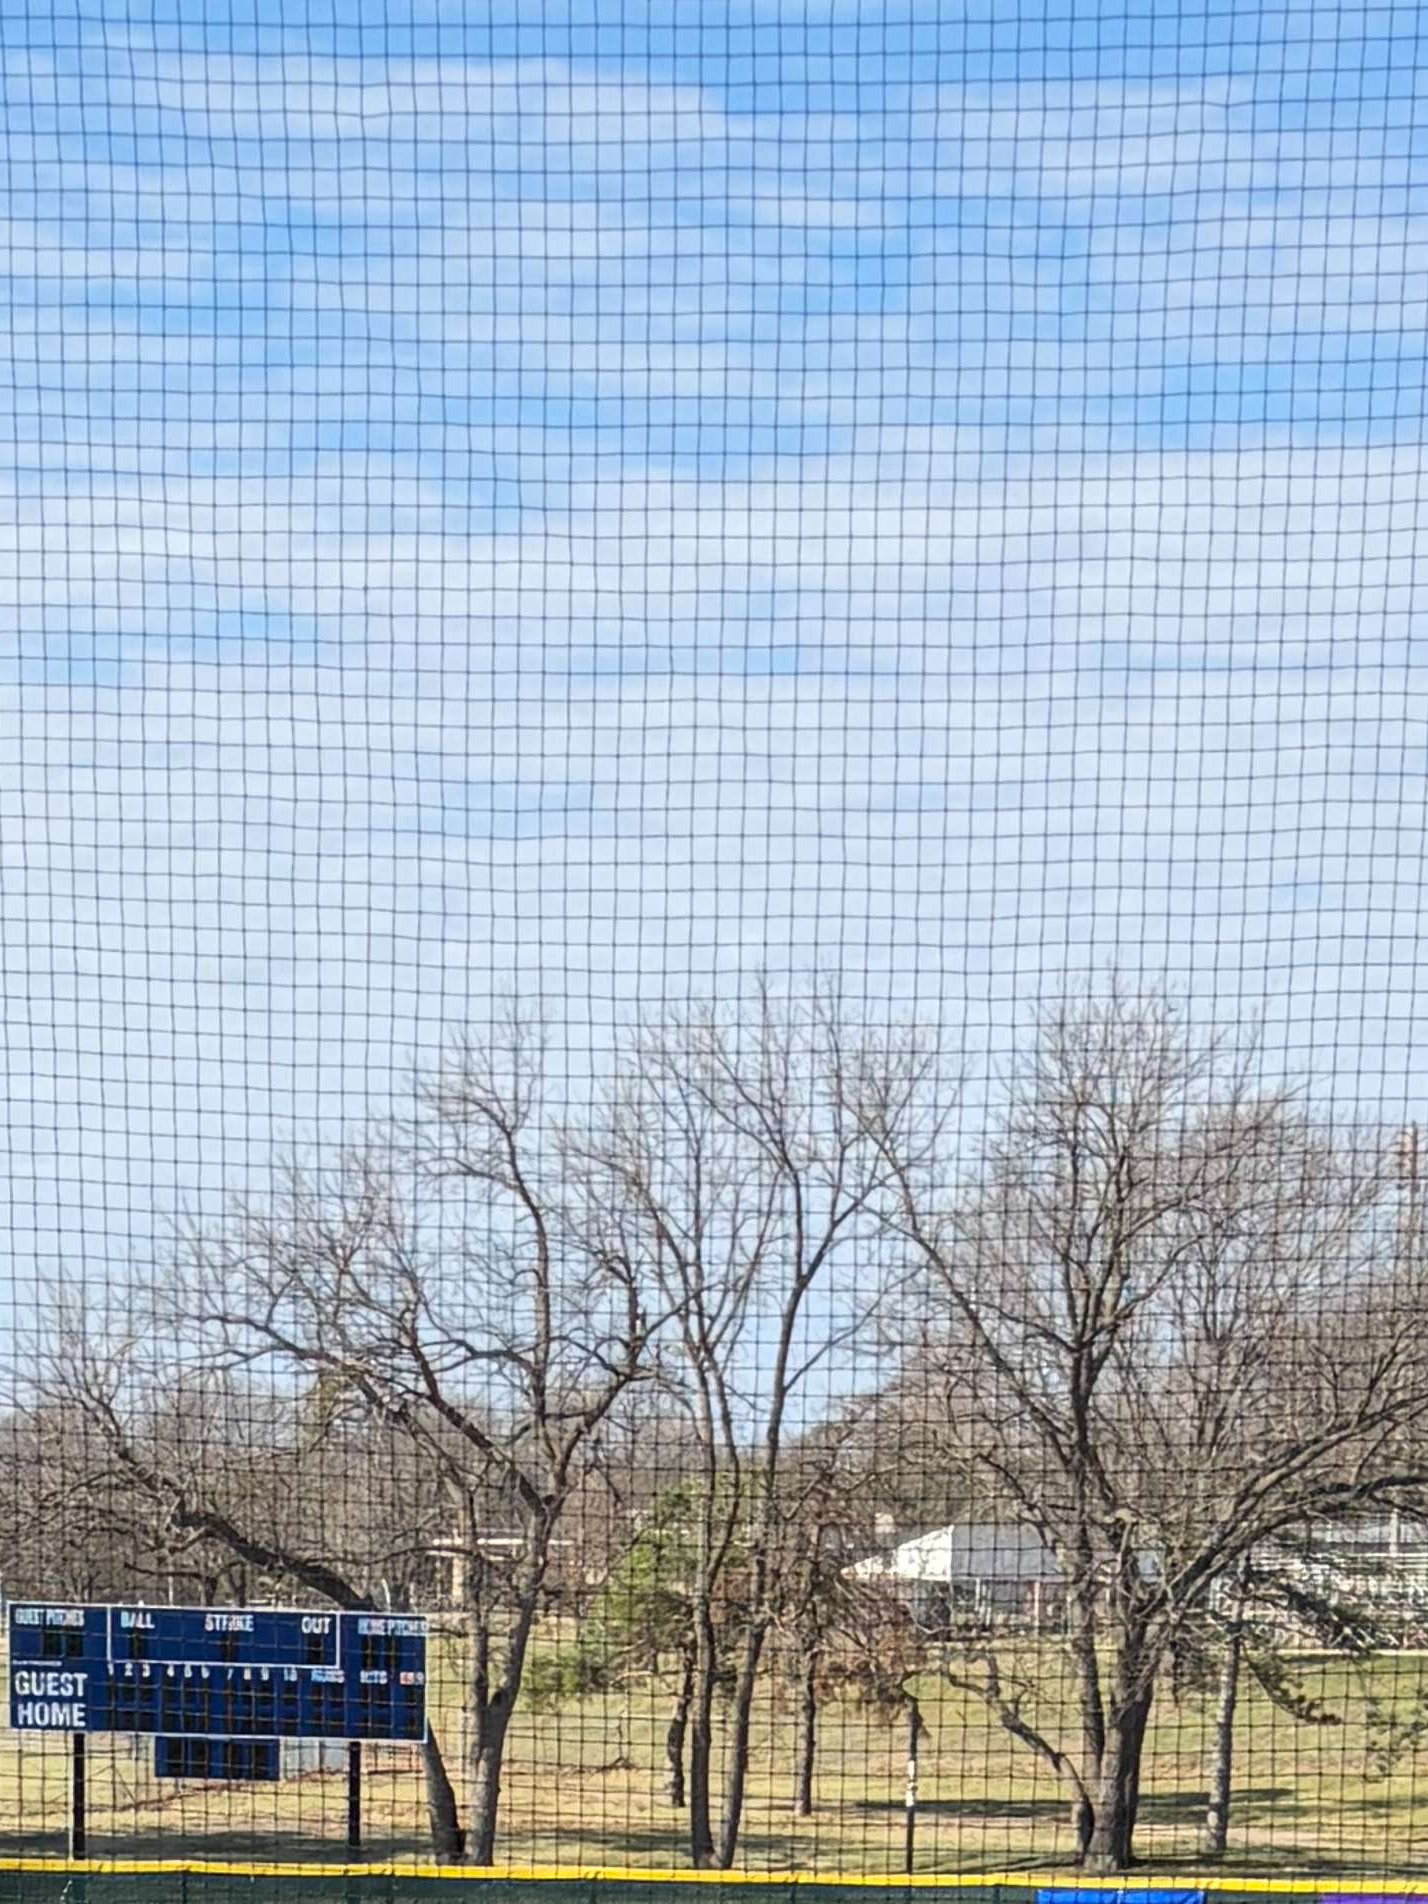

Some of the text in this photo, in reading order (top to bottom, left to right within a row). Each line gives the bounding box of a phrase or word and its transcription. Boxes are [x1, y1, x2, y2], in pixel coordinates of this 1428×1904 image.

[120, 1611, 155, 1629] BALL
[204, 1614, 254, 1632] STRIKE
[301, 1616, 332, 1634] OUT
[15, 1671, 88, 1697] GUEST
[17, 1702, 87, 1727] HOME
